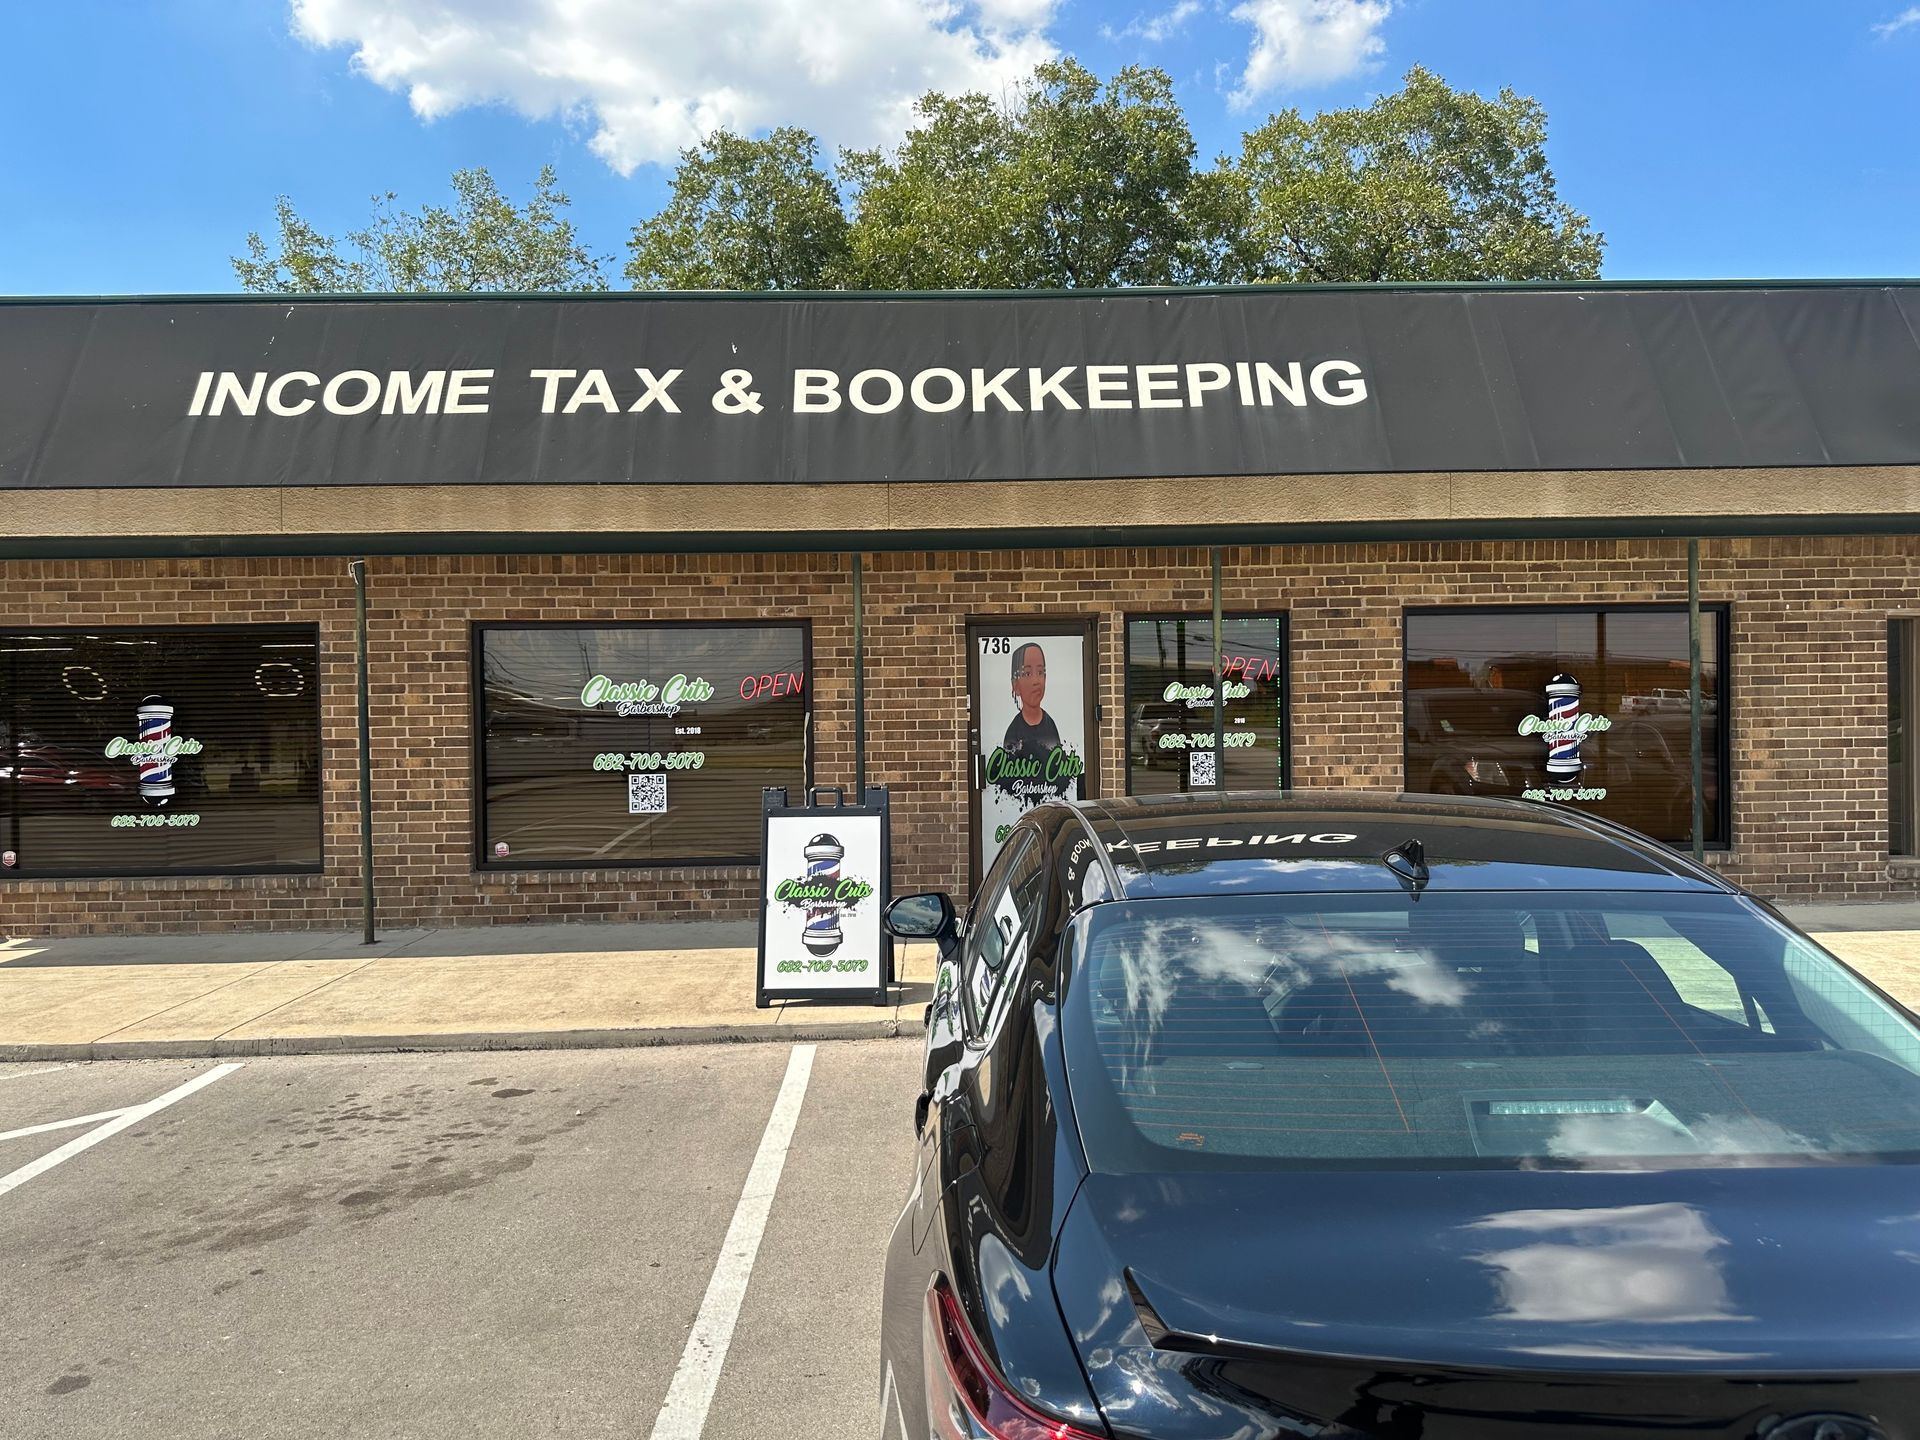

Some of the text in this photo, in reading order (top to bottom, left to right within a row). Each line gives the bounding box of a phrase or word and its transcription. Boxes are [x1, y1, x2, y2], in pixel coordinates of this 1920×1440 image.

[188, 359, 1368, 417] INCOME TAX & BOOKKEEPING
[981, 637, 1011, 655] 736
[580, 673, 715, 707] Classic Cuts
[740, 671, 804, 700] OPEN
[1163, 681, 1215, 703] Classic
[615, 700, 681, 718] Barbershop
[1517, 712, 1612, 737] Classic Cuts
[104, 735, 204, 759] Classic Cuts
[1158, 732, 1257, 749] 682-7085079
[592, 751, 706, 771] 682-708-5079
[985, 745, 1084, 785] Classic Cuts
[1011, 779, 1058, 797] Barbershop
[1522, 788, 1607, 801] 682-708-5079
[110, 814, 201, 828] 682-708-5079
[774, 878, 874, 902] Classic Cuts
[800, 898, 848, 911] Barbershop
[776, 960, 869, 973] 682-708-5079
